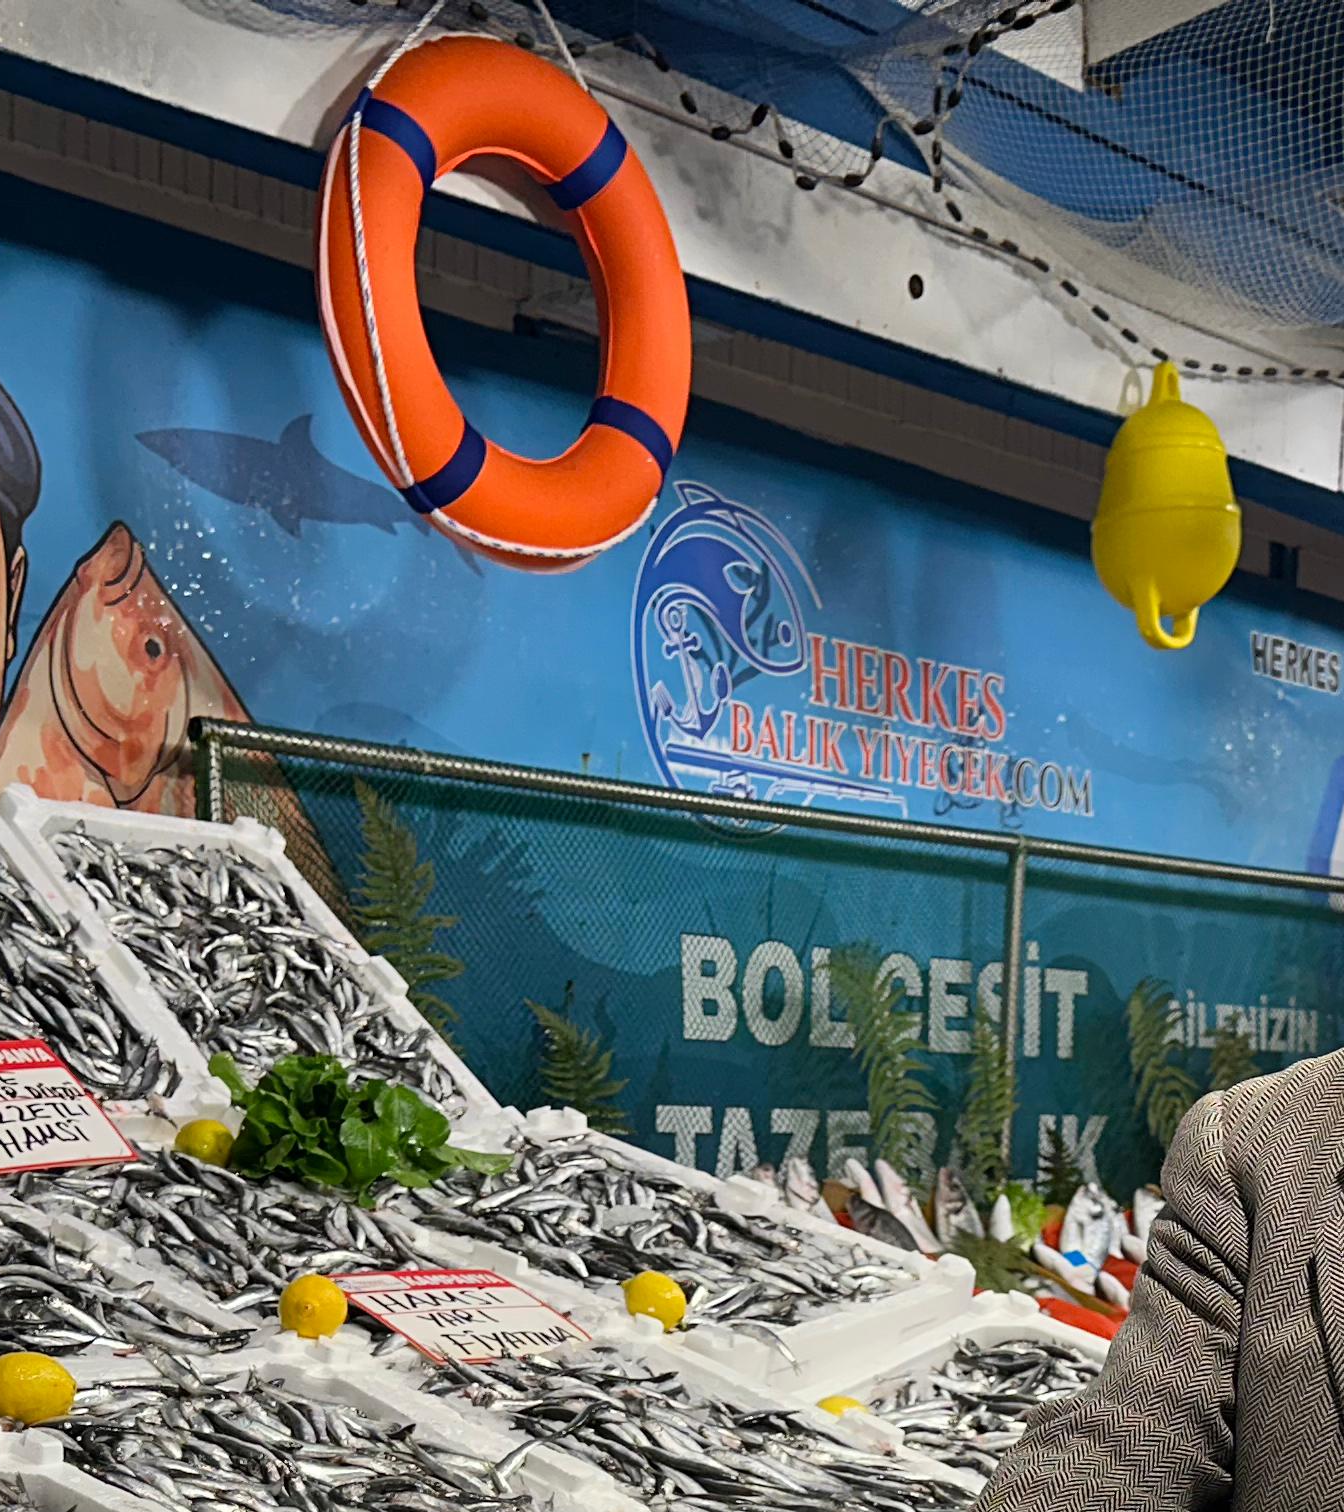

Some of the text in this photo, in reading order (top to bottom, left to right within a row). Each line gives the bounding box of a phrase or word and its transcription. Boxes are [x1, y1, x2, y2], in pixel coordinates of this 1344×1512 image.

[806, 632, 1007, 742] HERKES
[1250, 631, 1342, 696] HERKES
[729, 699, 1095, 817] BALIK YİYECEK.COM
[680, 932, 857, 1048] BOL
